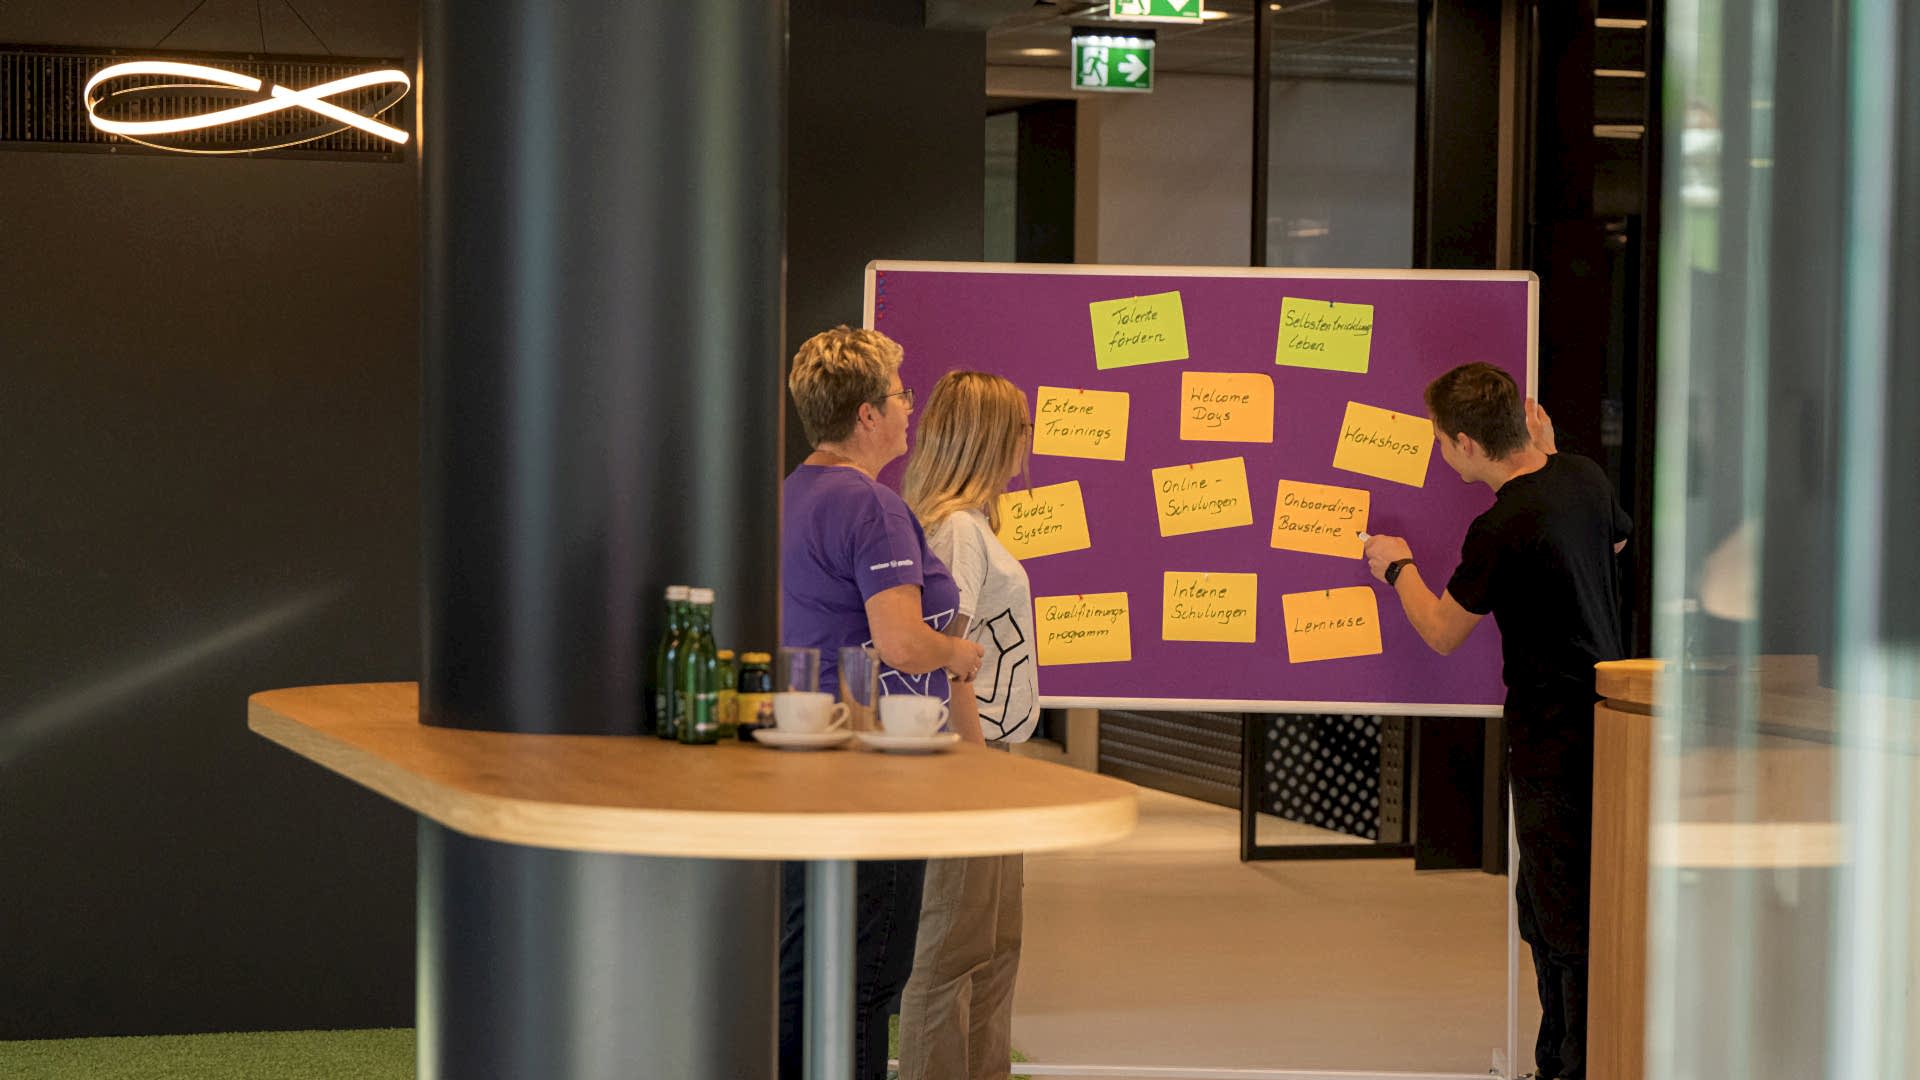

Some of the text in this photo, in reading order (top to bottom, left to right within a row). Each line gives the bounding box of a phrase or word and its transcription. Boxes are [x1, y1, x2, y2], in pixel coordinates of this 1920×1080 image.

[1190, 386, 1250, 404] Welcome
[1041, 398, 1094, 415] Externe
[1192, 406, 1231, 428] Days
[1046, 419, 1111, 446] Trainings
[1344, 425, 1419, 455] Workshops
[1165, 496, 1237, 517] Schulungen
[1013, 522, 1063, 545] System
[1278, 515, 1343, 537] Bausteine
[1172, 579, 1227, 599] Interne
[1170, 603, 1247, 625] Schulungen
